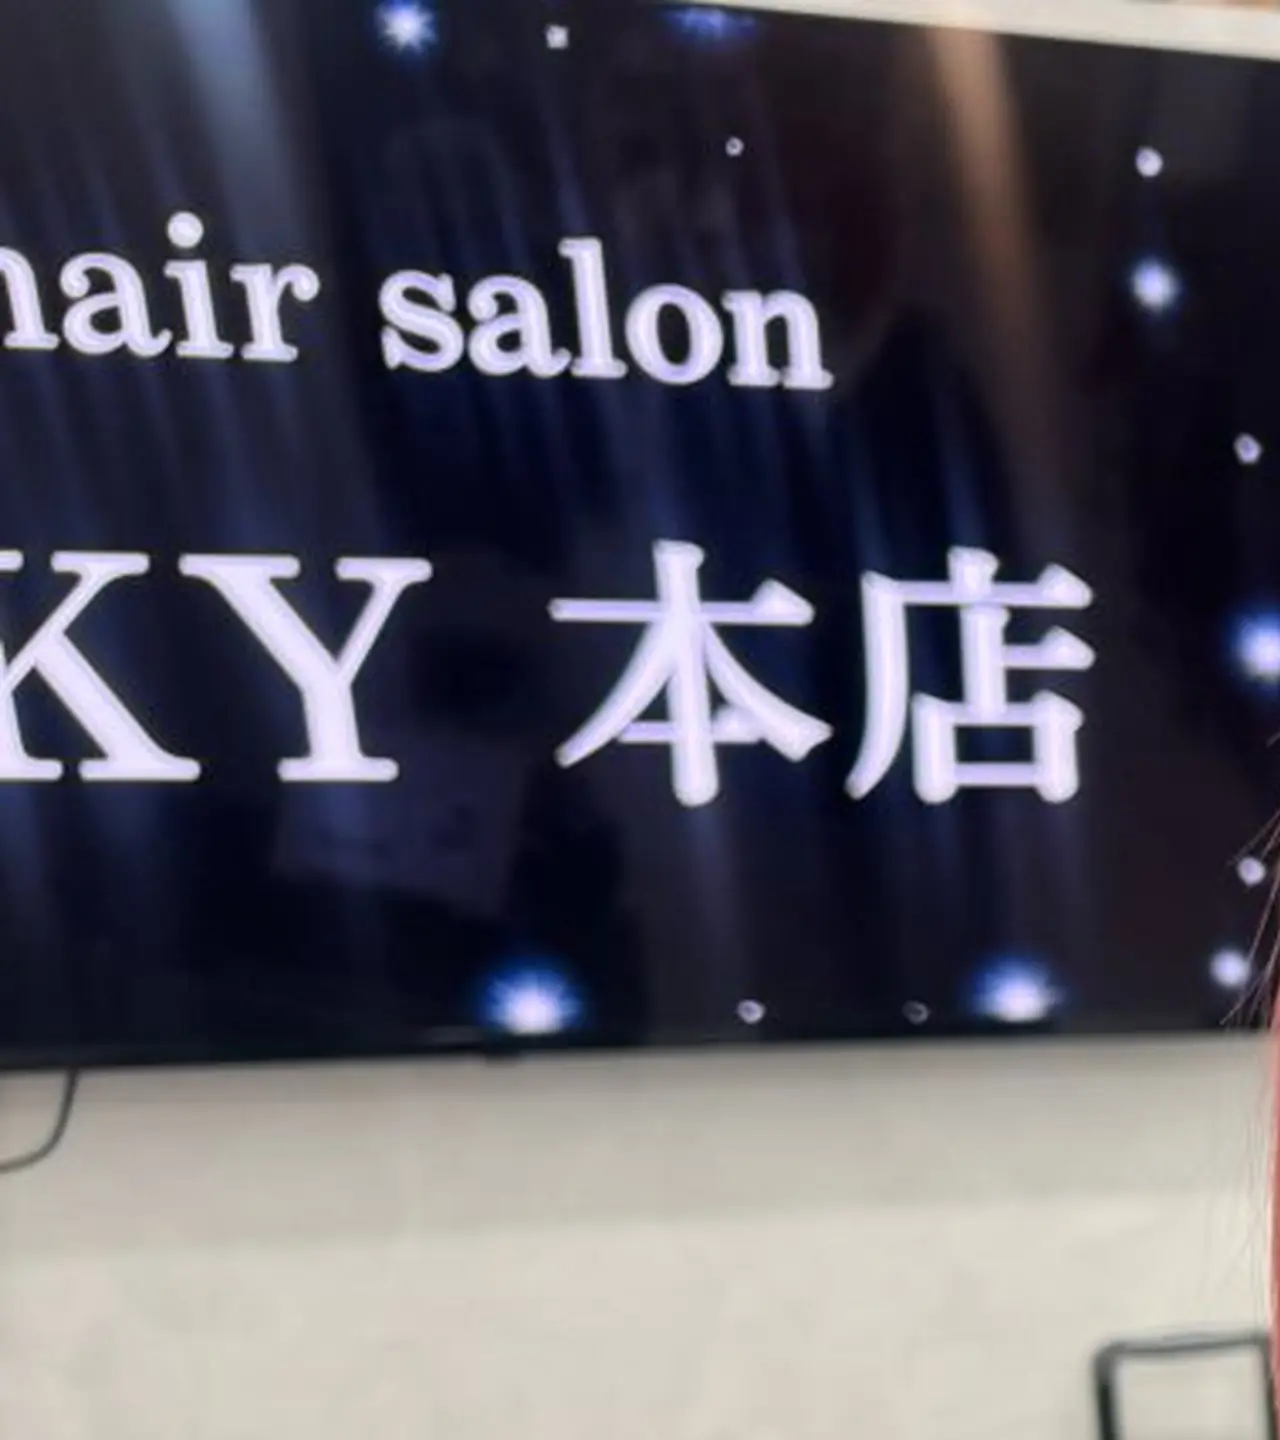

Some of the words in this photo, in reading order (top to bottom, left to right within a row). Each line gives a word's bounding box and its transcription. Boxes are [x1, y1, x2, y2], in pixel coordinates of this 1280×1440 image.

[379, 237, 833, 390] salon
[0, 550, 432, 782] KY
[550, 540, 1095, 807] 本店
